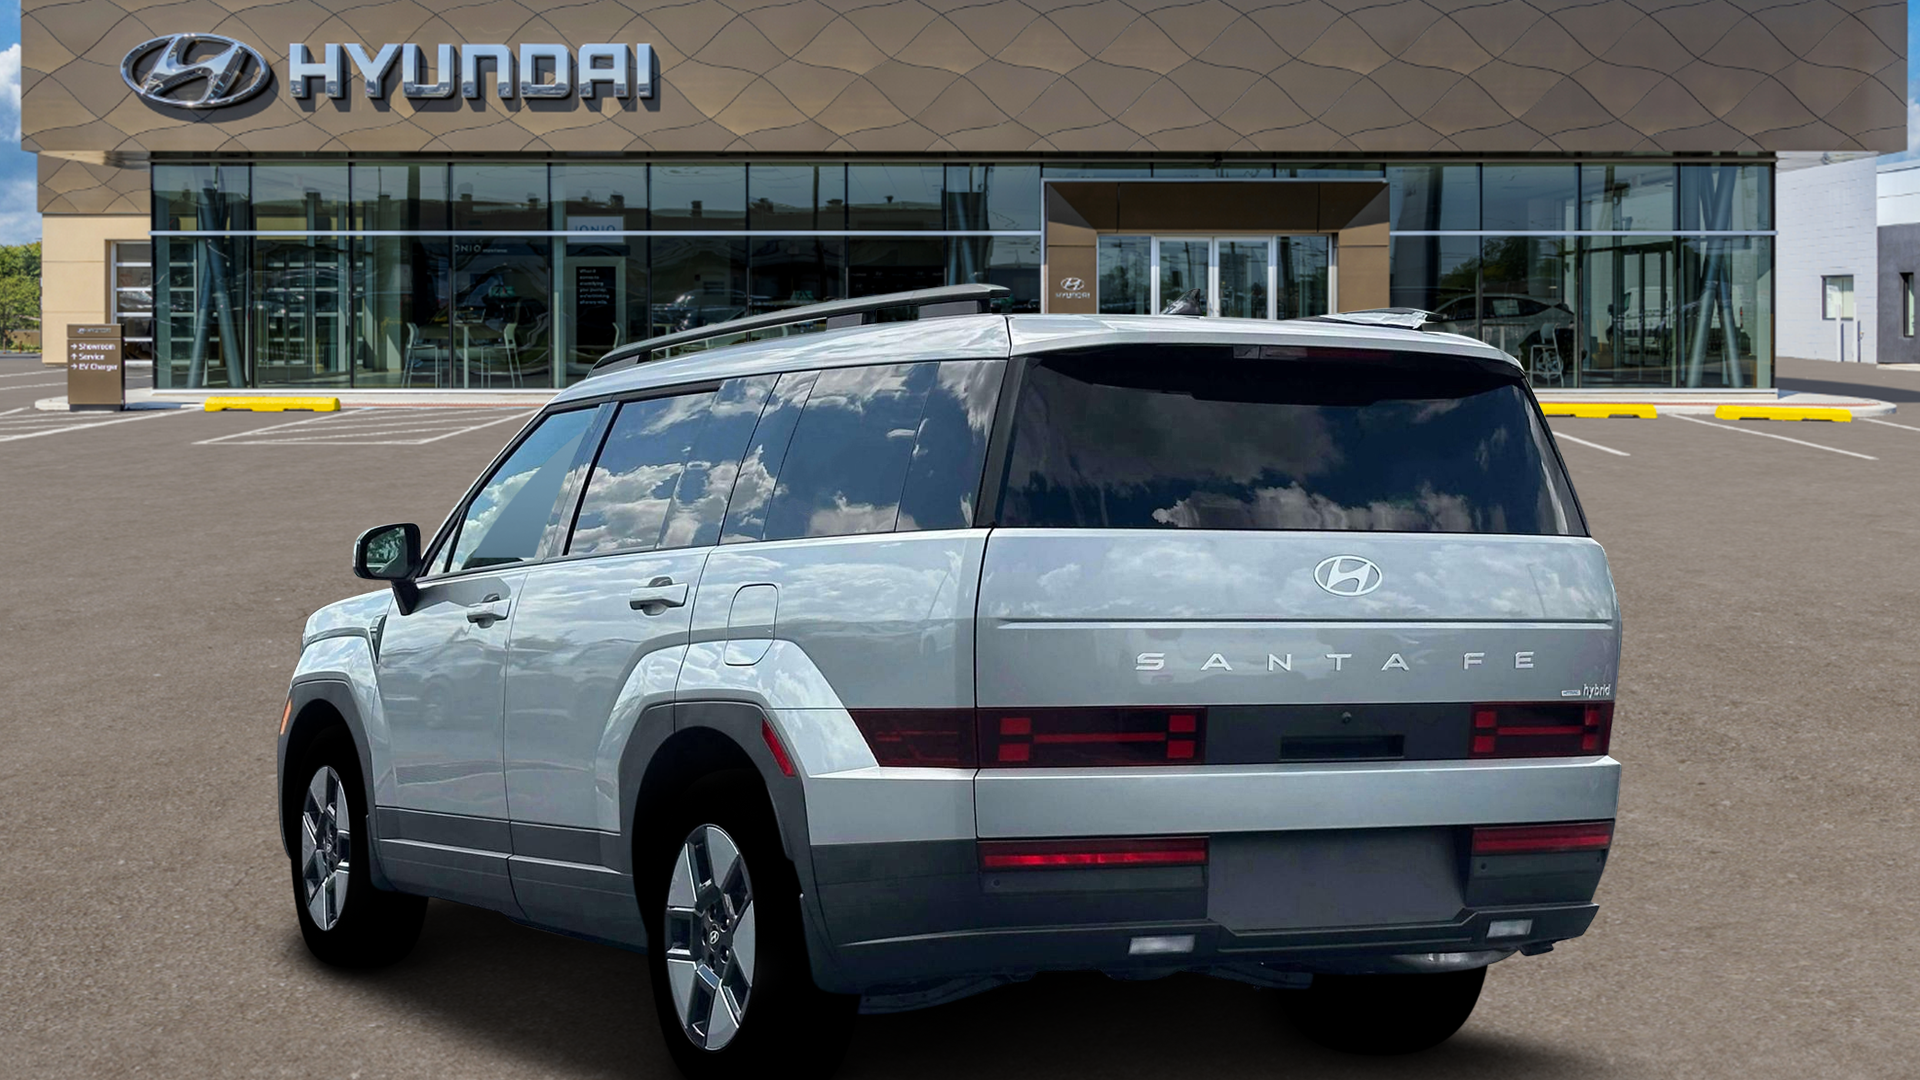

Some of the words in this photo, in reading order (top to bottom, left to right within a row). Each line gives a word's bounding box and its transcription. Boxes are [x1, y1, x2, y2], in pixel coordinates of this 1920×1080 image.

[289, 43, 654, 98] HYUNDAI
[79, 352, 105, 360] Service
[90, 363, 118, 371] Charger
[1135, 652, 1409, 672] SANTA
[1463, 651, 1535, 670] FE
[1583, 684, 1611, 699] hybrid
